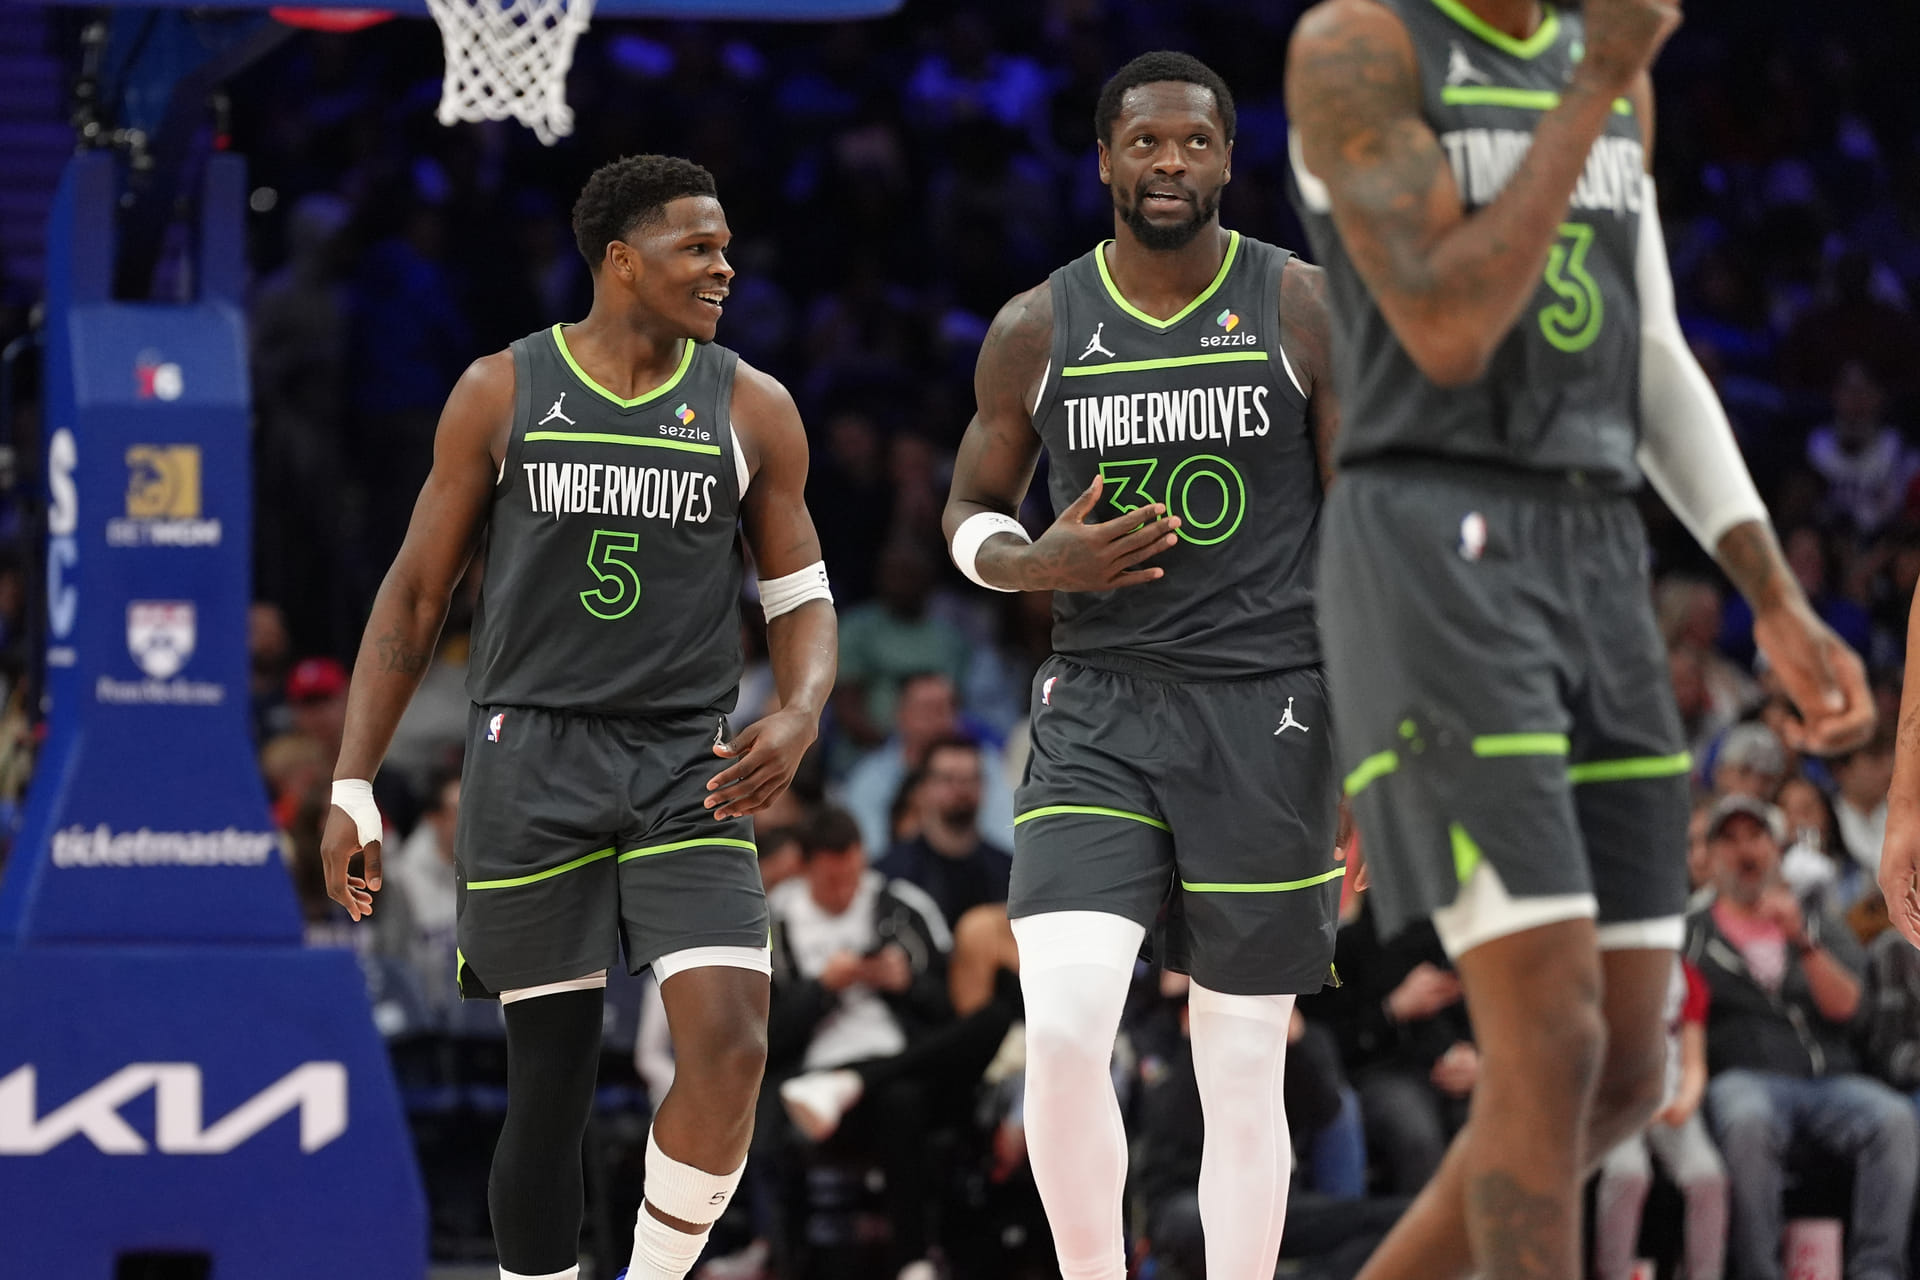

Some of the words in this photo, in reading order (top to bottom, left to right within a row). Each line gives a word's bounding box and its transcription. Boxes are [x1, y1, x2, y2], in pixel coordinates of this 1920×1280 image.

[1538, 223, 1604, 352] 3
[1200, 331, 1257, 347] sezzle
[659, 423, 711, 442] sezzle
[1063, 385, 1270, 457] TIMBERWOLVES
[522, 462, 718, 529] TIMBERWOLVES
[1098, 453, 1247, 546] 30
[580, 529, 642, 620] 5
[51, 824, 273, 868] ticketmaster
[708, 1190, 728, 1206] 5
